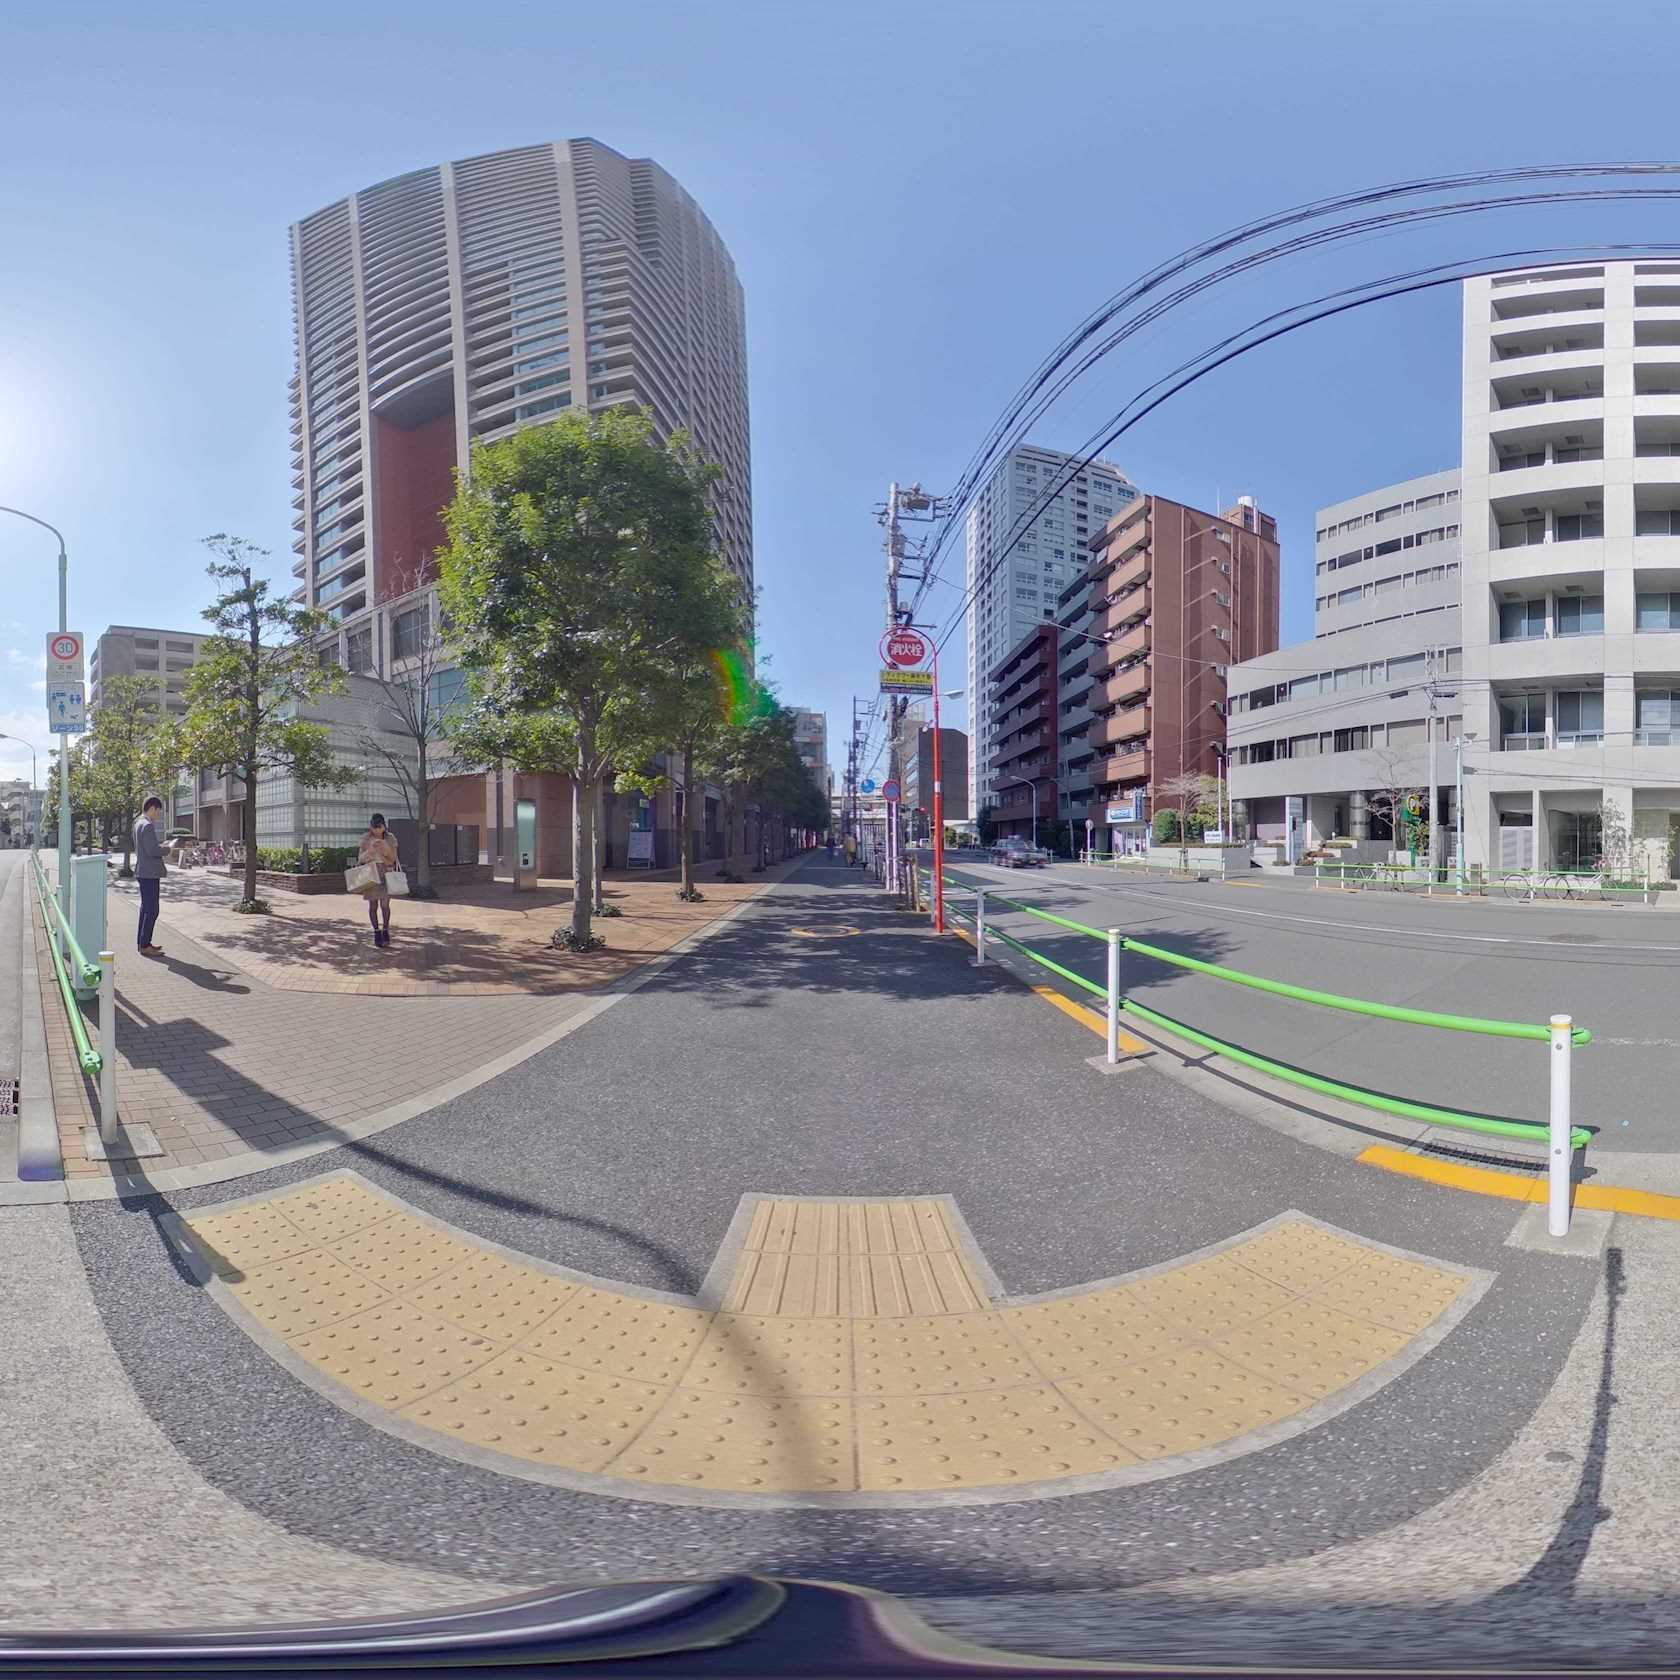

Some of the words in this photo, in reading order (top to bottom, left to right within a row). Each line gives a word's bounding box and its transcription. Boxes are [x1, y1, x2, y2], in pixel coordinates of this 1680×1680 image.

[57, 642, 73, 654] 30
[890, 642, 923, 657] 消火栓
